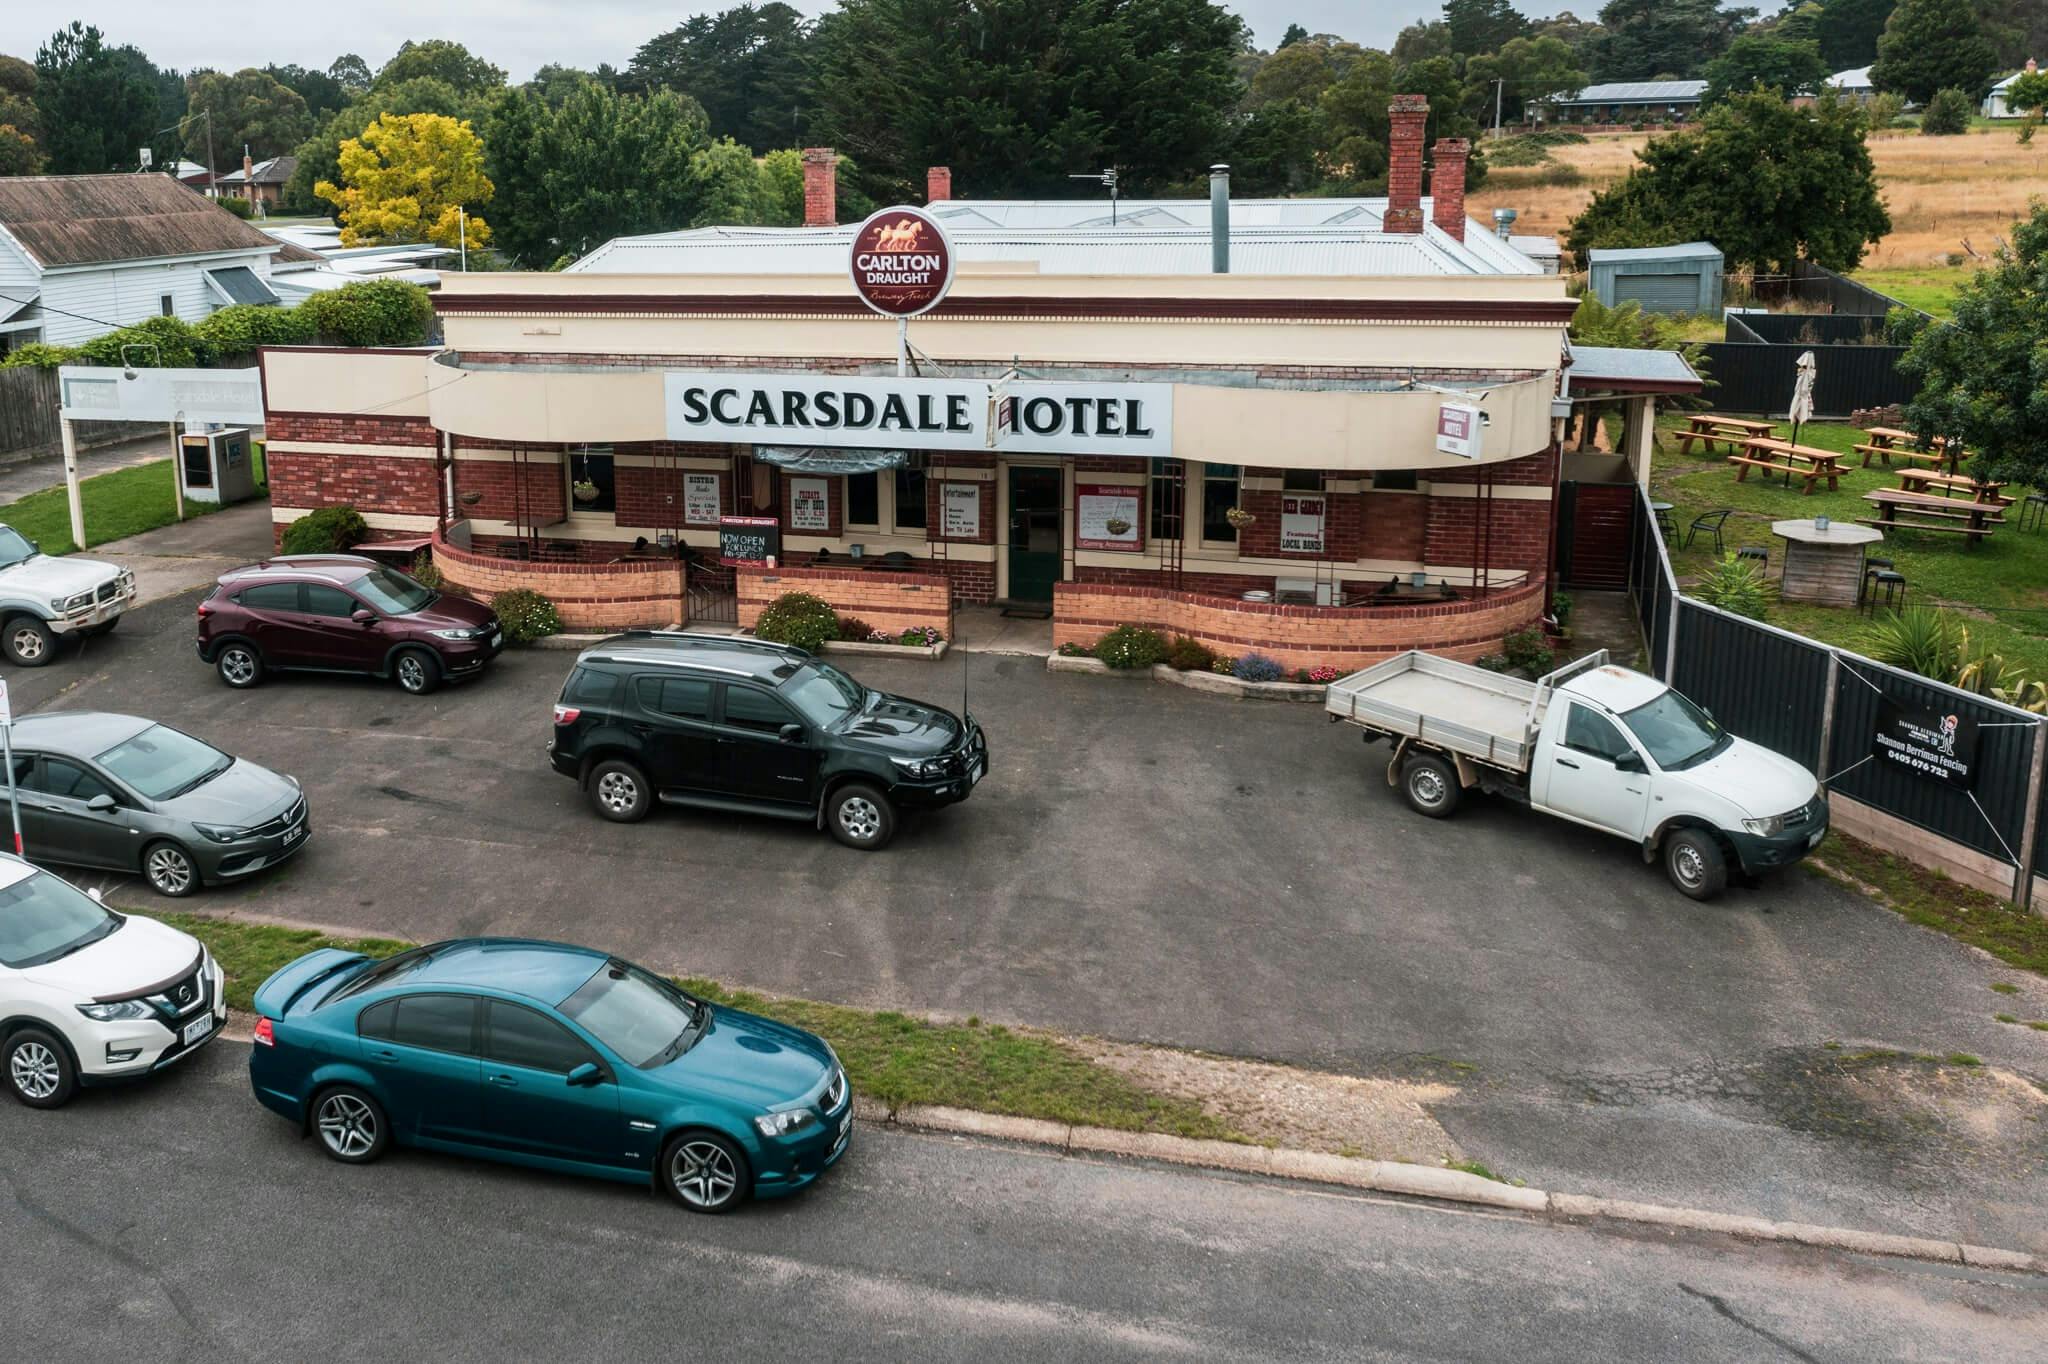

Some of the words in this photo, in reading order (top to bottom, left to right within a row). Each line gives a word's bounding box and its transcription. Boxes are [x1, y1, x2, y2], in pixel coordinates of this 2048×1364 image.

[857, 254, 940, 271] CARLTON
[866, 272, 930, 284] DRAUGHT
[683, 387, 973, 432] SCARSDALE
[721, 534, 739, 545] NOW
[740, 536, 765, 546] OPEN
[1282, 539, 1300, 549] LOCAL
[1876, 732, 1906, 751] Shannon
[1906, 743, 1939, 763] Berriman
[1939, 755, 1968, 775] Fencing
[1888, 749, 1911, 764] 0405
[1911, 759, 1930, 771] 676
[1930, 764, 1949, 778] 722
